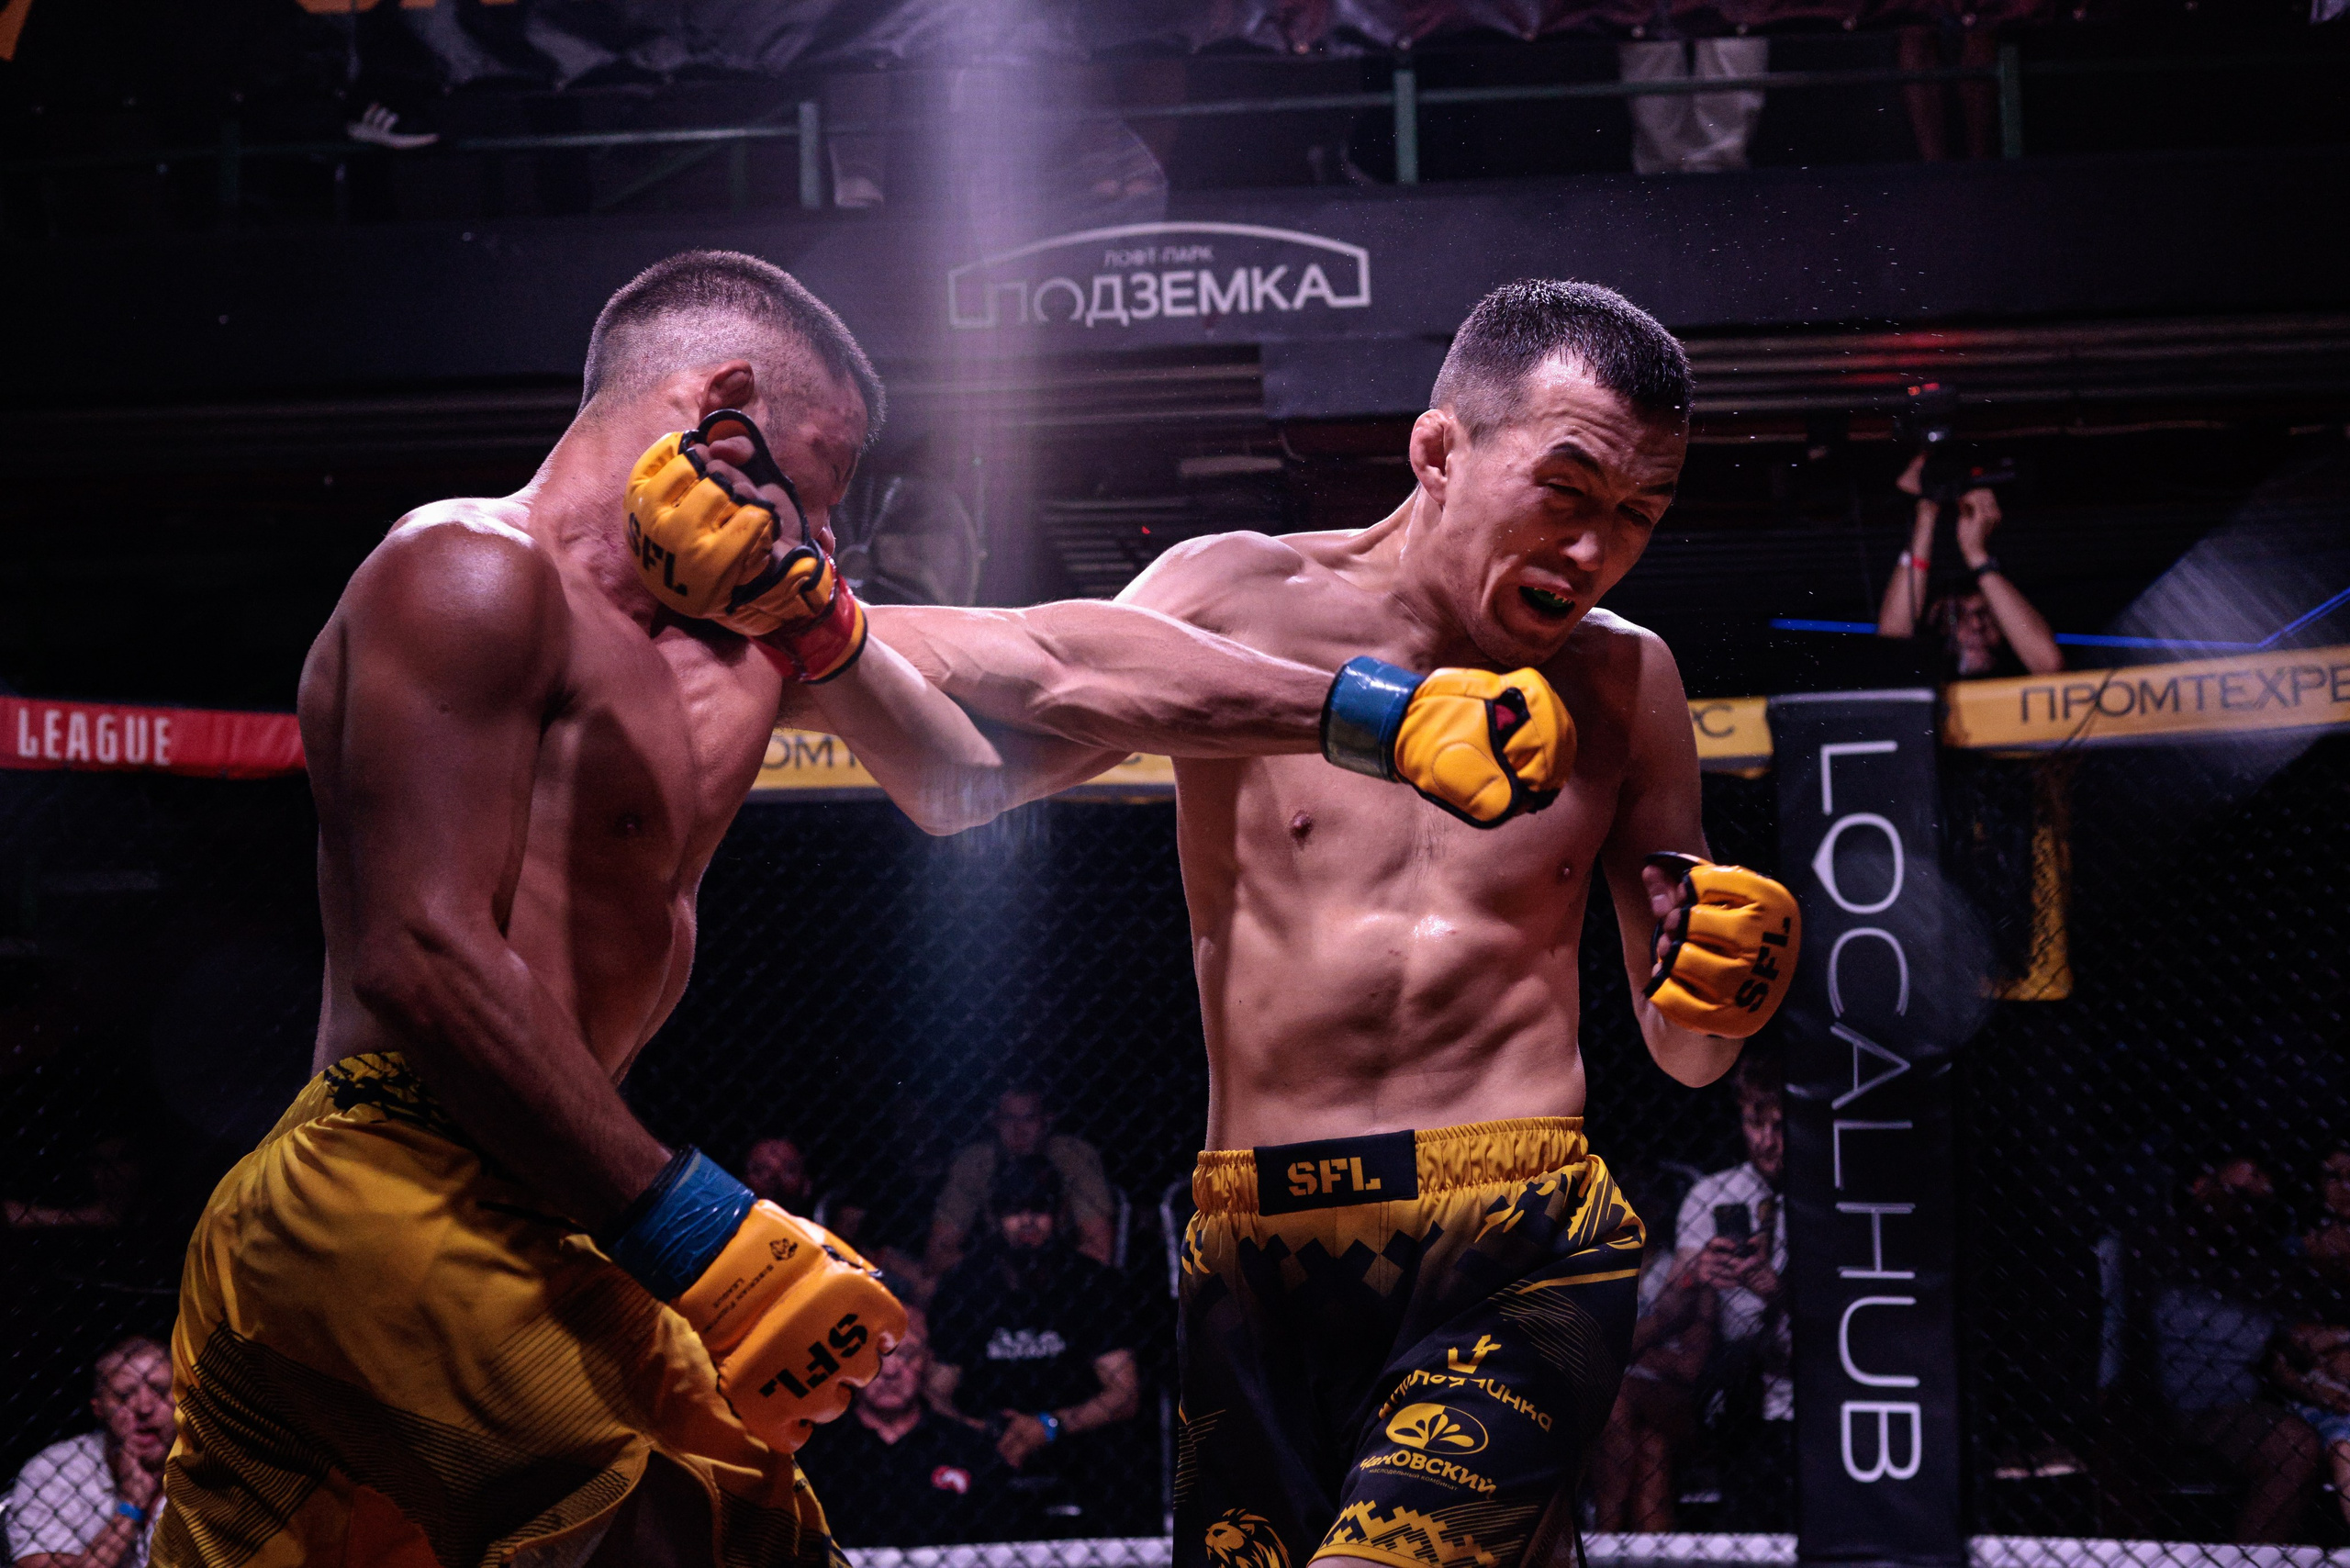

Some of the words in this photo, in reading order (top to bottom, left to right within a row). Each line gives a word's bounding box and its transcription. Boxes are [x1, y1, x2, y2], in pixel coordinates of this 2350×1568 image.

[990, 262, 1331, 328] ПОДЗЕМКА
[628, 511, 688, 597] SFL
[17, 706, 173, 767] LEAGUE
[1735, 917, 1791, 1014] SFL
[1811, 740, 1923, 1484] LOCALHUB
[1287, 1156, 1382, 1197] SFL
[759, 1313, 868, 1399] SFL
